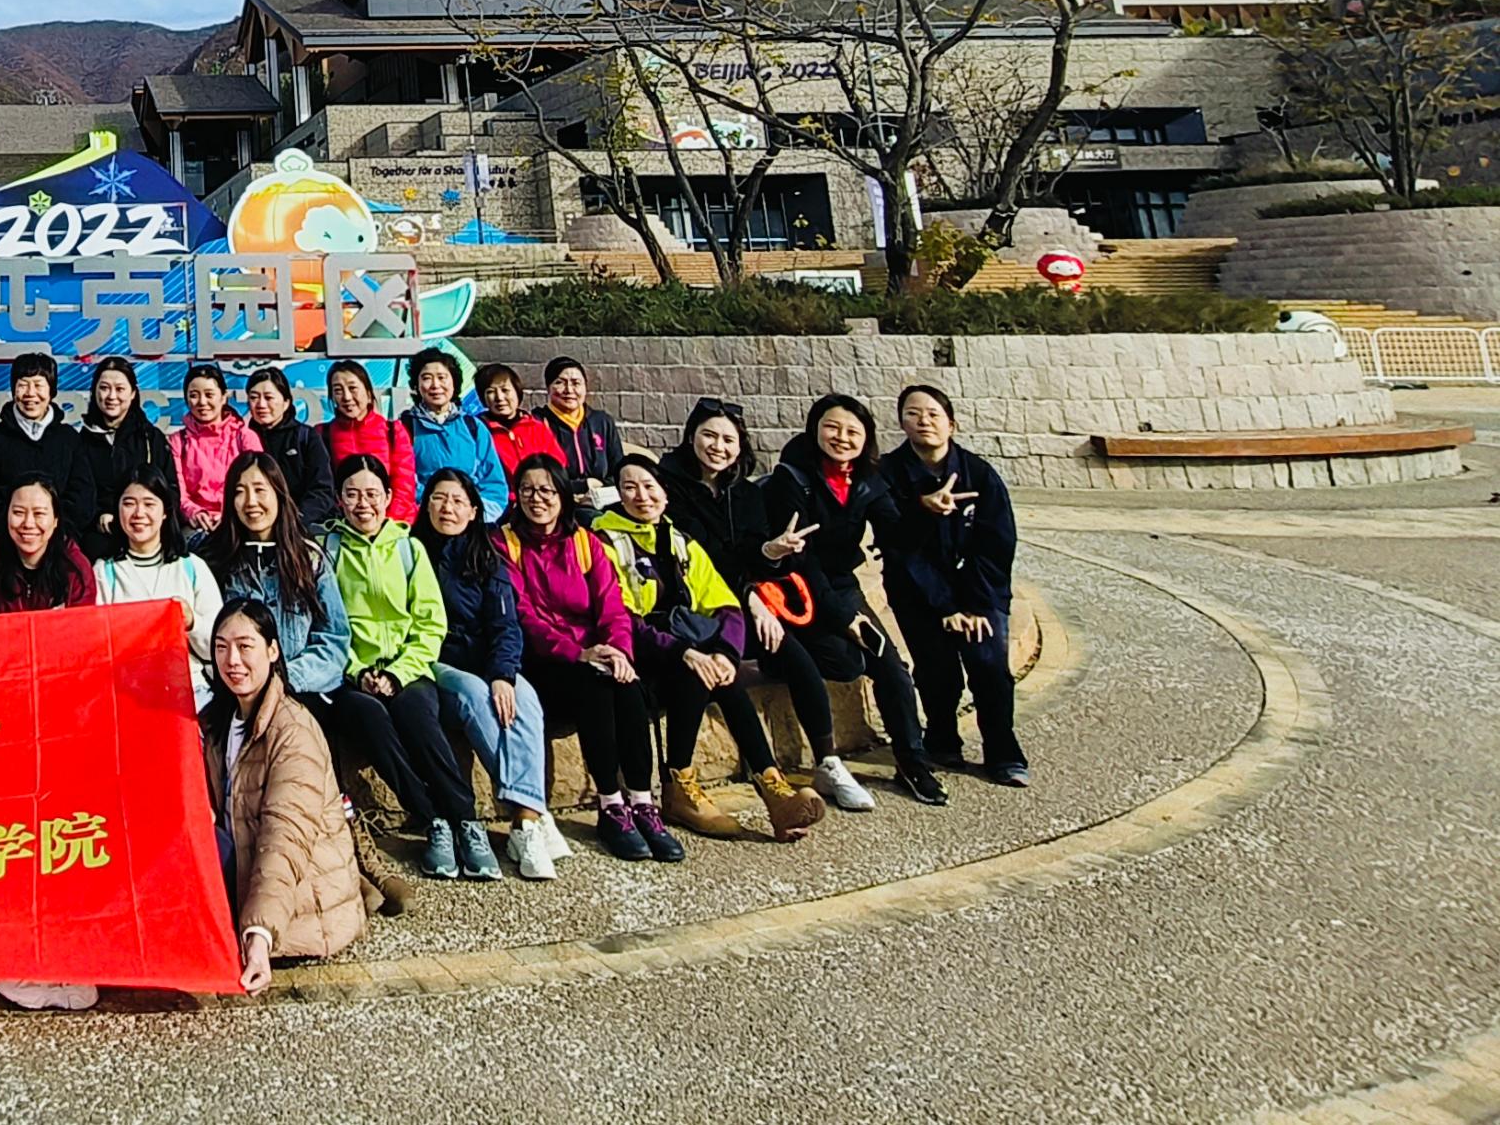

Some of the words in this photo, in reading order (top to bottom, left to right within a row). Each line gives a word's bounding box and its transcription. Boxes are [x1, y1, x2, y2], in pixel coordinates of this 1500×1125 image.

[370, 166, 415, 177] Together
[418, 166, 432, 176] for
[433, 167, 441, 175] a
[488, 166, 517, 175] uture
